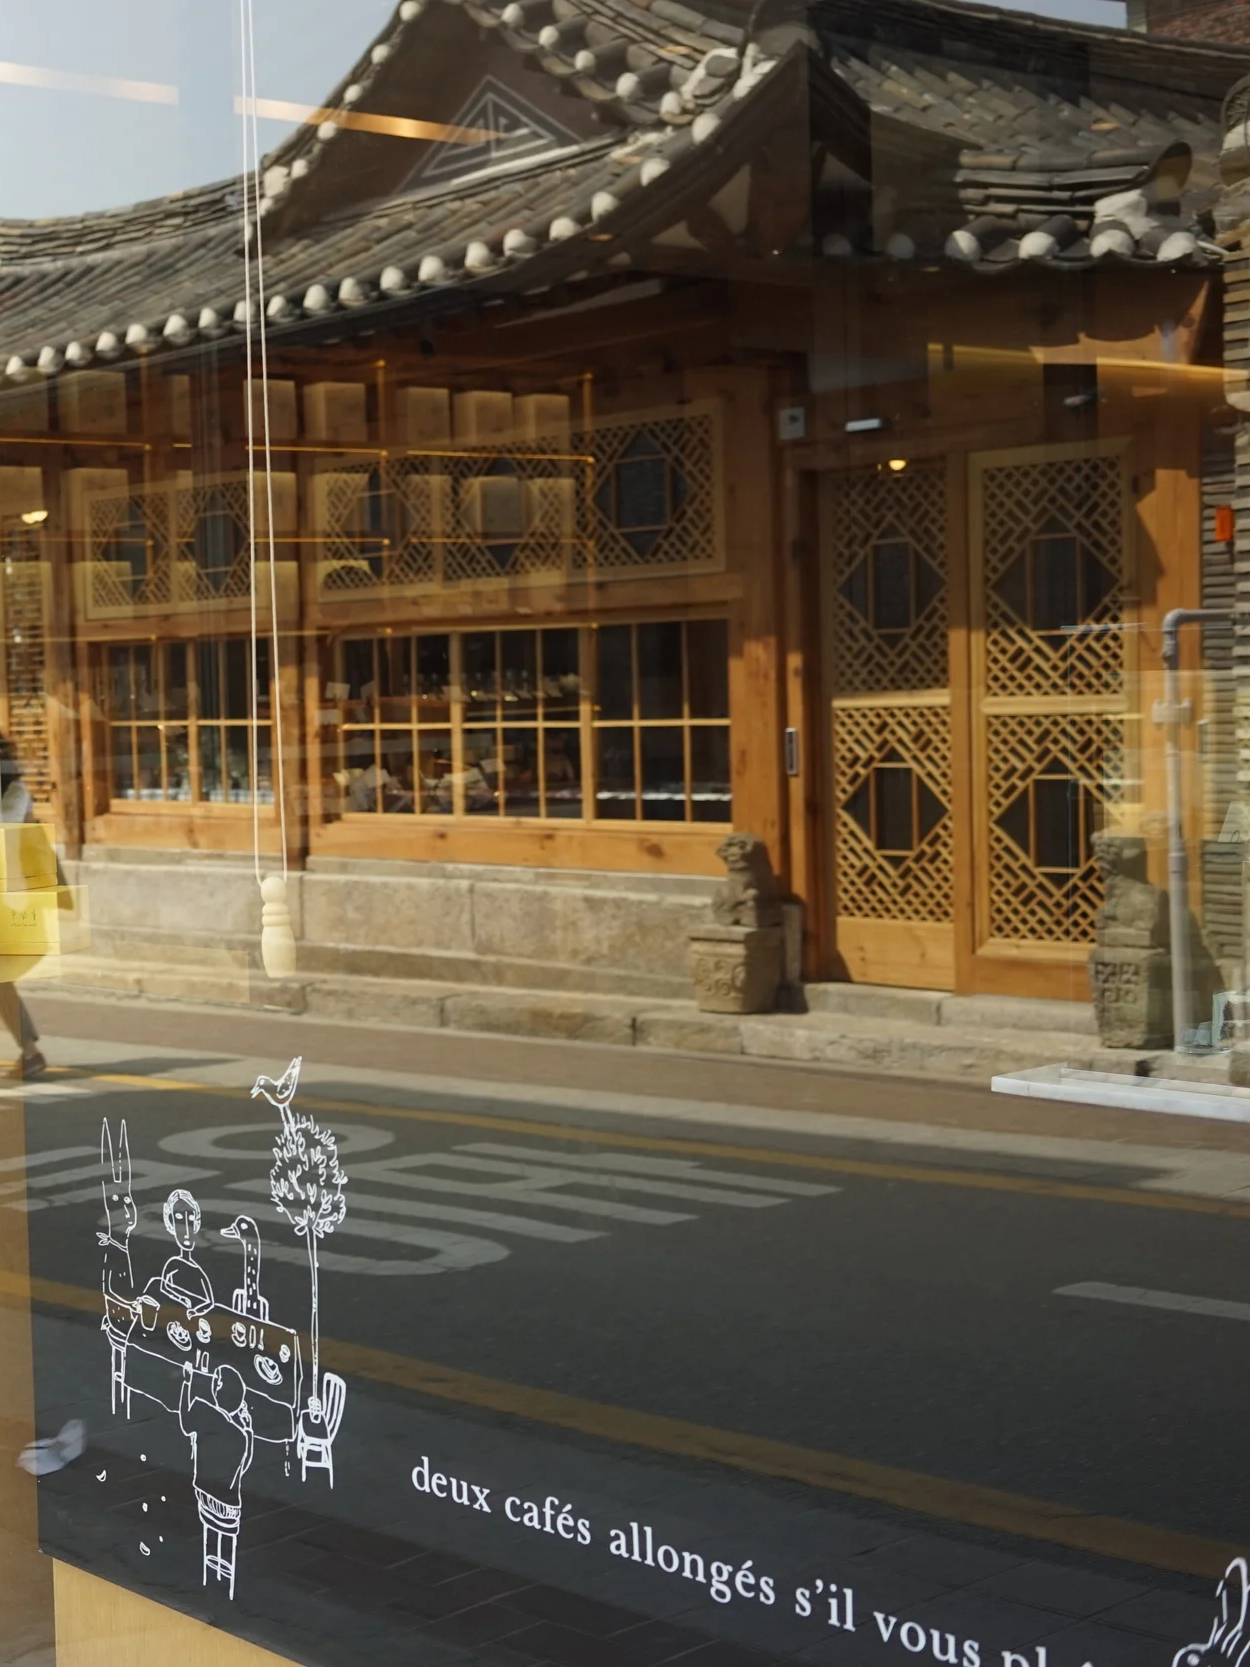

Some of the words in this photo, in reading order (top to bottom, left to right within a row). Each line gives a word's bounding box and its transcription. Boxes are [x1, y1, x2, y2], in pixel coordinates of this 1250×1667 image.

[411, 1455, 492, 1514] deux
[504, 1496, 592, 1546] cafés
[609, 1521, 776, 1606] allongés
[873, 1611, 981, 1667] vous
